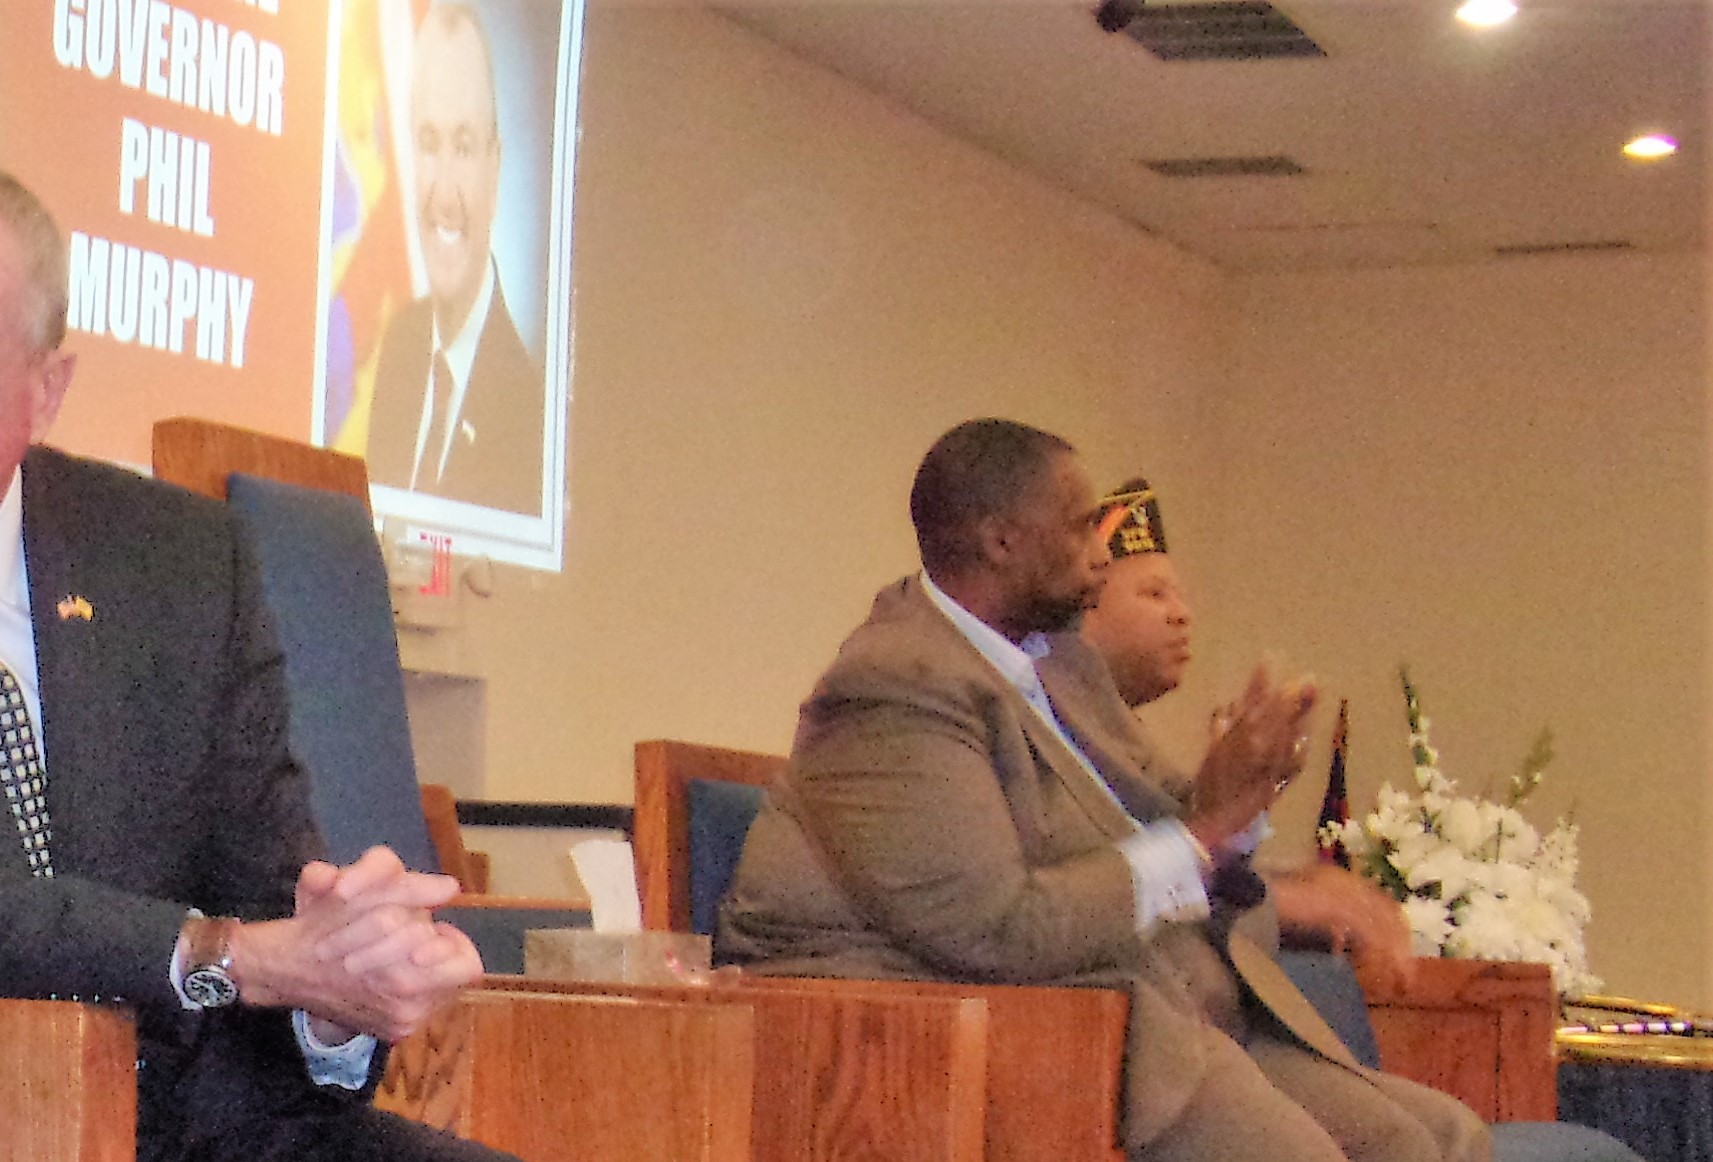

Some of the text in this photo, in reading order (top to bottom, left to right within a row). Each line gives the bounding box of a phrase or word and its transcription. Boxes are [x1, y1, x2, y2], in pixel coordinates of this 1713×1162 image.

[52, 0, 285, 137] GOVERNOR
[118, 116, 215, 238] PHIL
[66, 230, 255, 369] MURPHY
